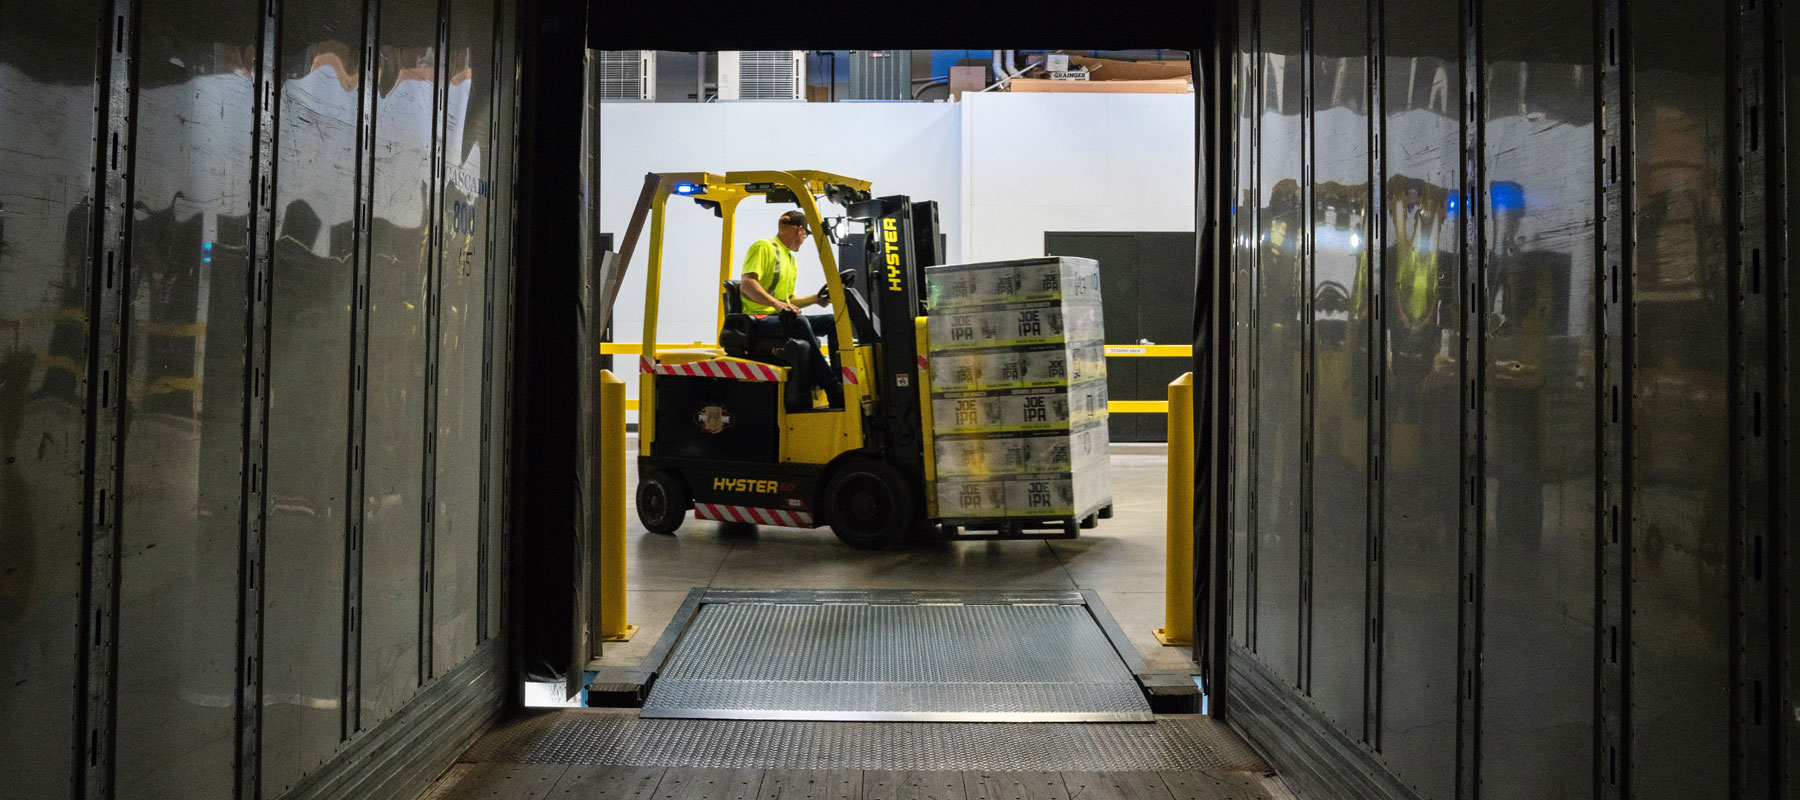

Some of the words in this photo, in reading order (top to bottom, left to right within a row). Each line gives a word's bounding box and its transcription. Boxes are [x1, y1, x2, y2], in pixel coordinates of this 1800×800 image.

[882, 217, 902, 292] HYSTER
[1042, 274, 1058, 283] JOE
[1042, 281, 1058, 292] IPA
[950, 316, 972, 327] JOE
[1018, 310, 1040, 322] JOE
[951, 326, 974, 340] IPA
[1018, 322, 1041, 337] IPA
[1002, 362, 1017, 371] JOE
[1048, 360, 1064, 369] JOE
[1002, 370, 1019, 380] IPA
[1048, 367, 1064, 378] IPA
[955, 400, 977, 411] JOE
[1023, 397, 1045, 408] JOE
[956, 410, 978, 425] IPA
[1024, 407, 1047, 422] IPA
[712, 477, 779, 494] HYSTER
[959, 484, 981, 495] JOE
[1028, 482, 1050, 493] JOE
[960, 494, 982, 509] IPA
[1028, 492, 1051, 508] IPA
